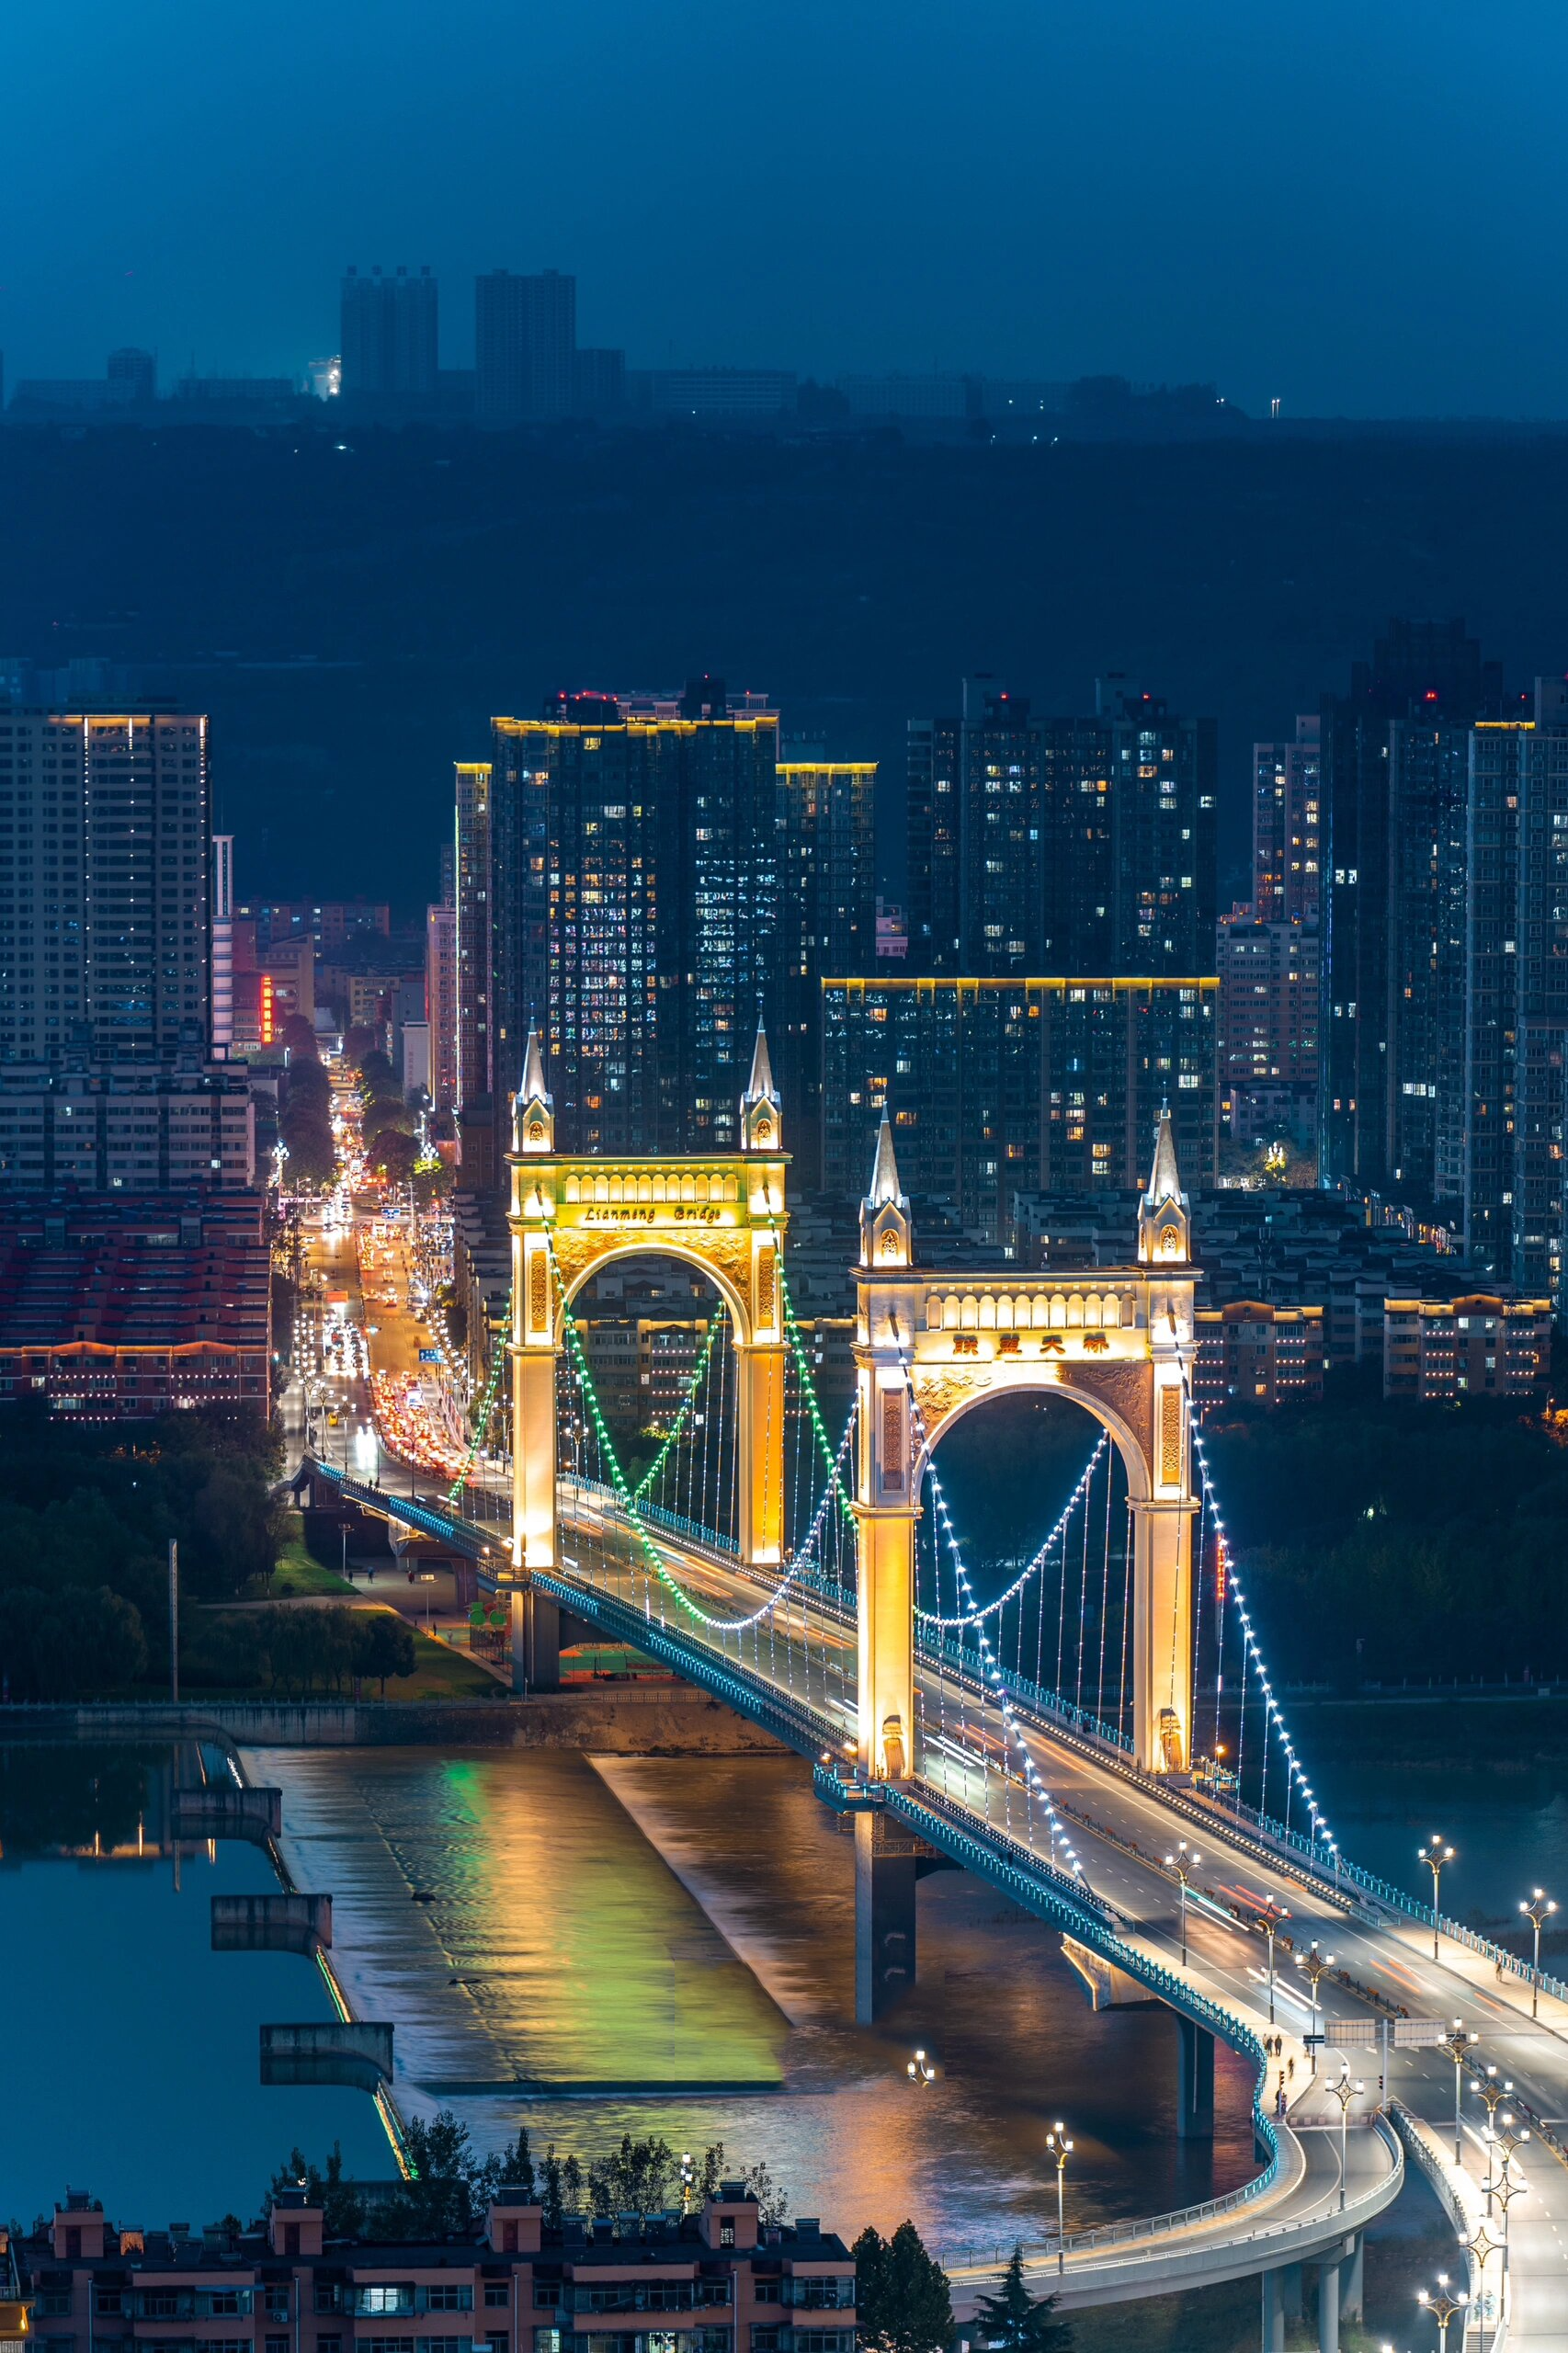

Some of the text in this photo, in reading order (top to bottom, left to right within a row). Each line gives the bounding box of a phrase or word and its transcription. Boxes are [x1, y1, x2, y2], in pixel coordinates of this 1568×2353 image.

[585, 1206, 721, 1223] Lianmeng Bridge
[953, 1334, 1109, 1356] 联盟大桥
